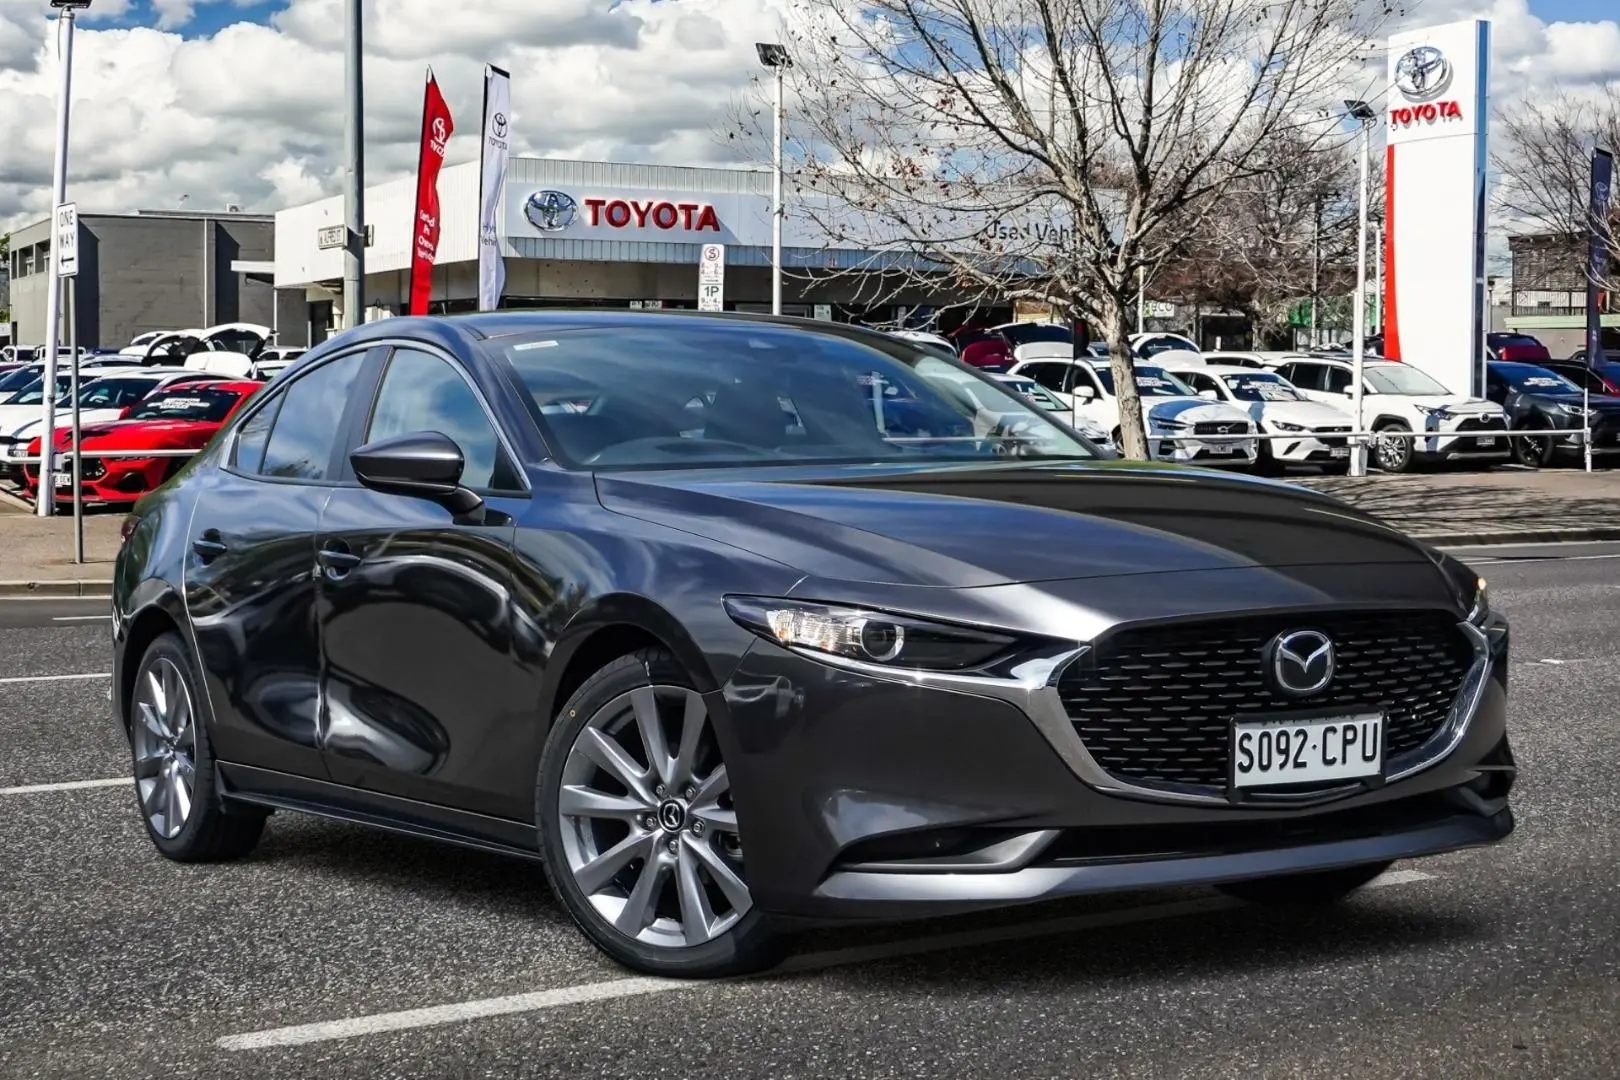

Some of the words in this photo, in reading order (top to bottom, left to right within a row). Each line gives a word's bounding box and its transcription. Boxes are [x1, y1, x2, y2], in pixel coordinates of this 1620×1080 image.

[1390, 101, 1461, 124] TOYOTA
[60, 209, 73, 227] ONE
[584, 199, 720, 232] TOYOTA
[59, 231, 75, 249] WAY
[704, 286, 719, 297] 1P
